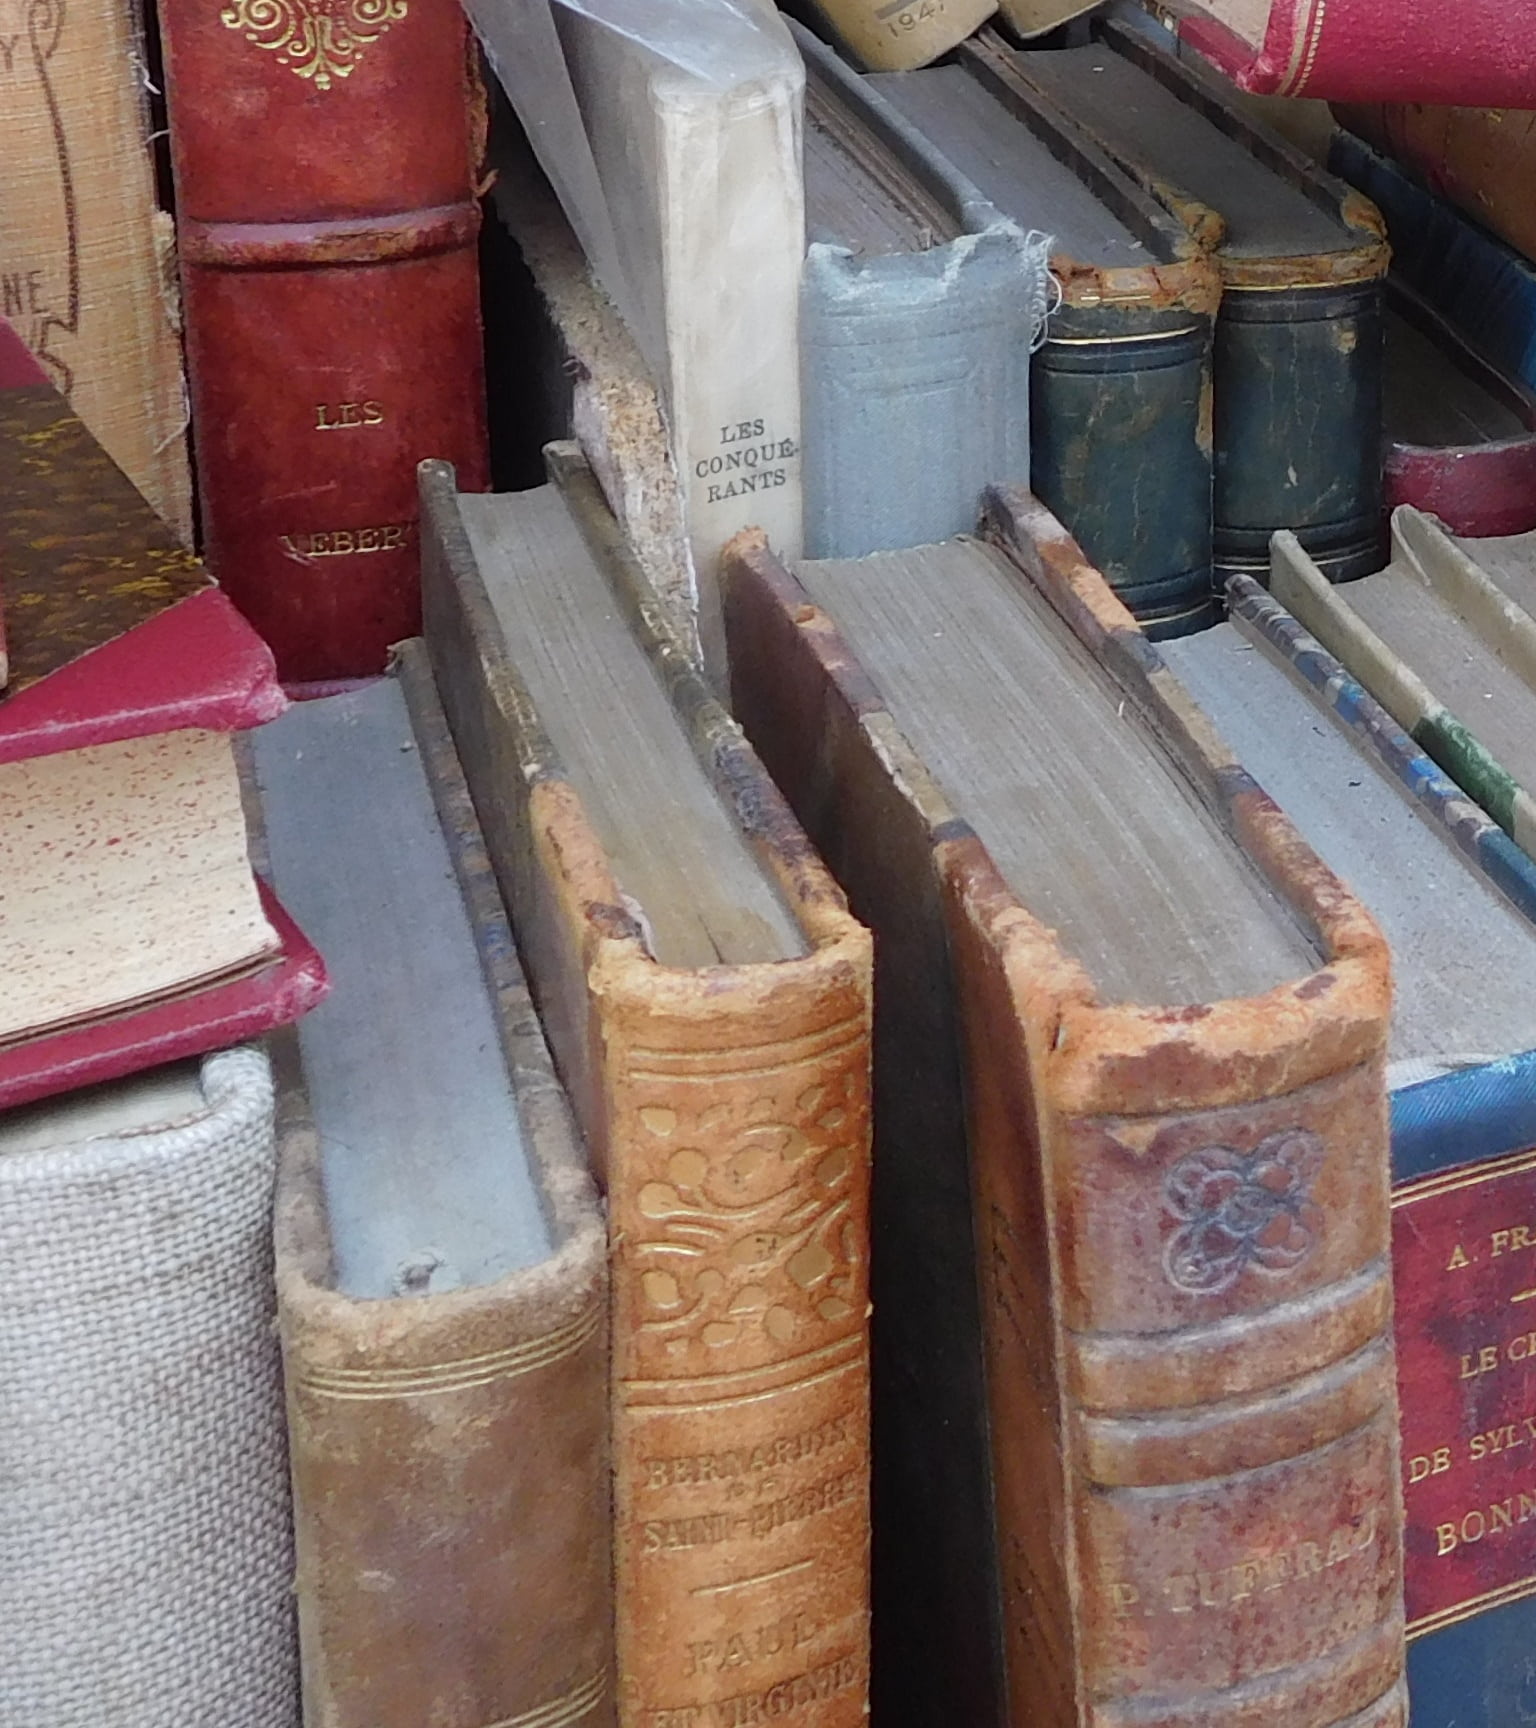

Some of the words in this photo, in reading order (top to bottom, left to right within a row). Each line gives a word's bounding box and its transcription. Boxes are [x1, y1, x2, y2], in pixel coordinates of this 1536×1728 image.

[314, 400, 385, 431] LES
[719, 418, 767, 445] LES
[705, 467, 788, 504] RANTS
[1445, 1240, 1486, 1275] A.
[1456, 1339, 1505, 1383] LE
[1406, 1440, 1454, 1486] DE
[685, 1609, 820, 1680] PAUL
